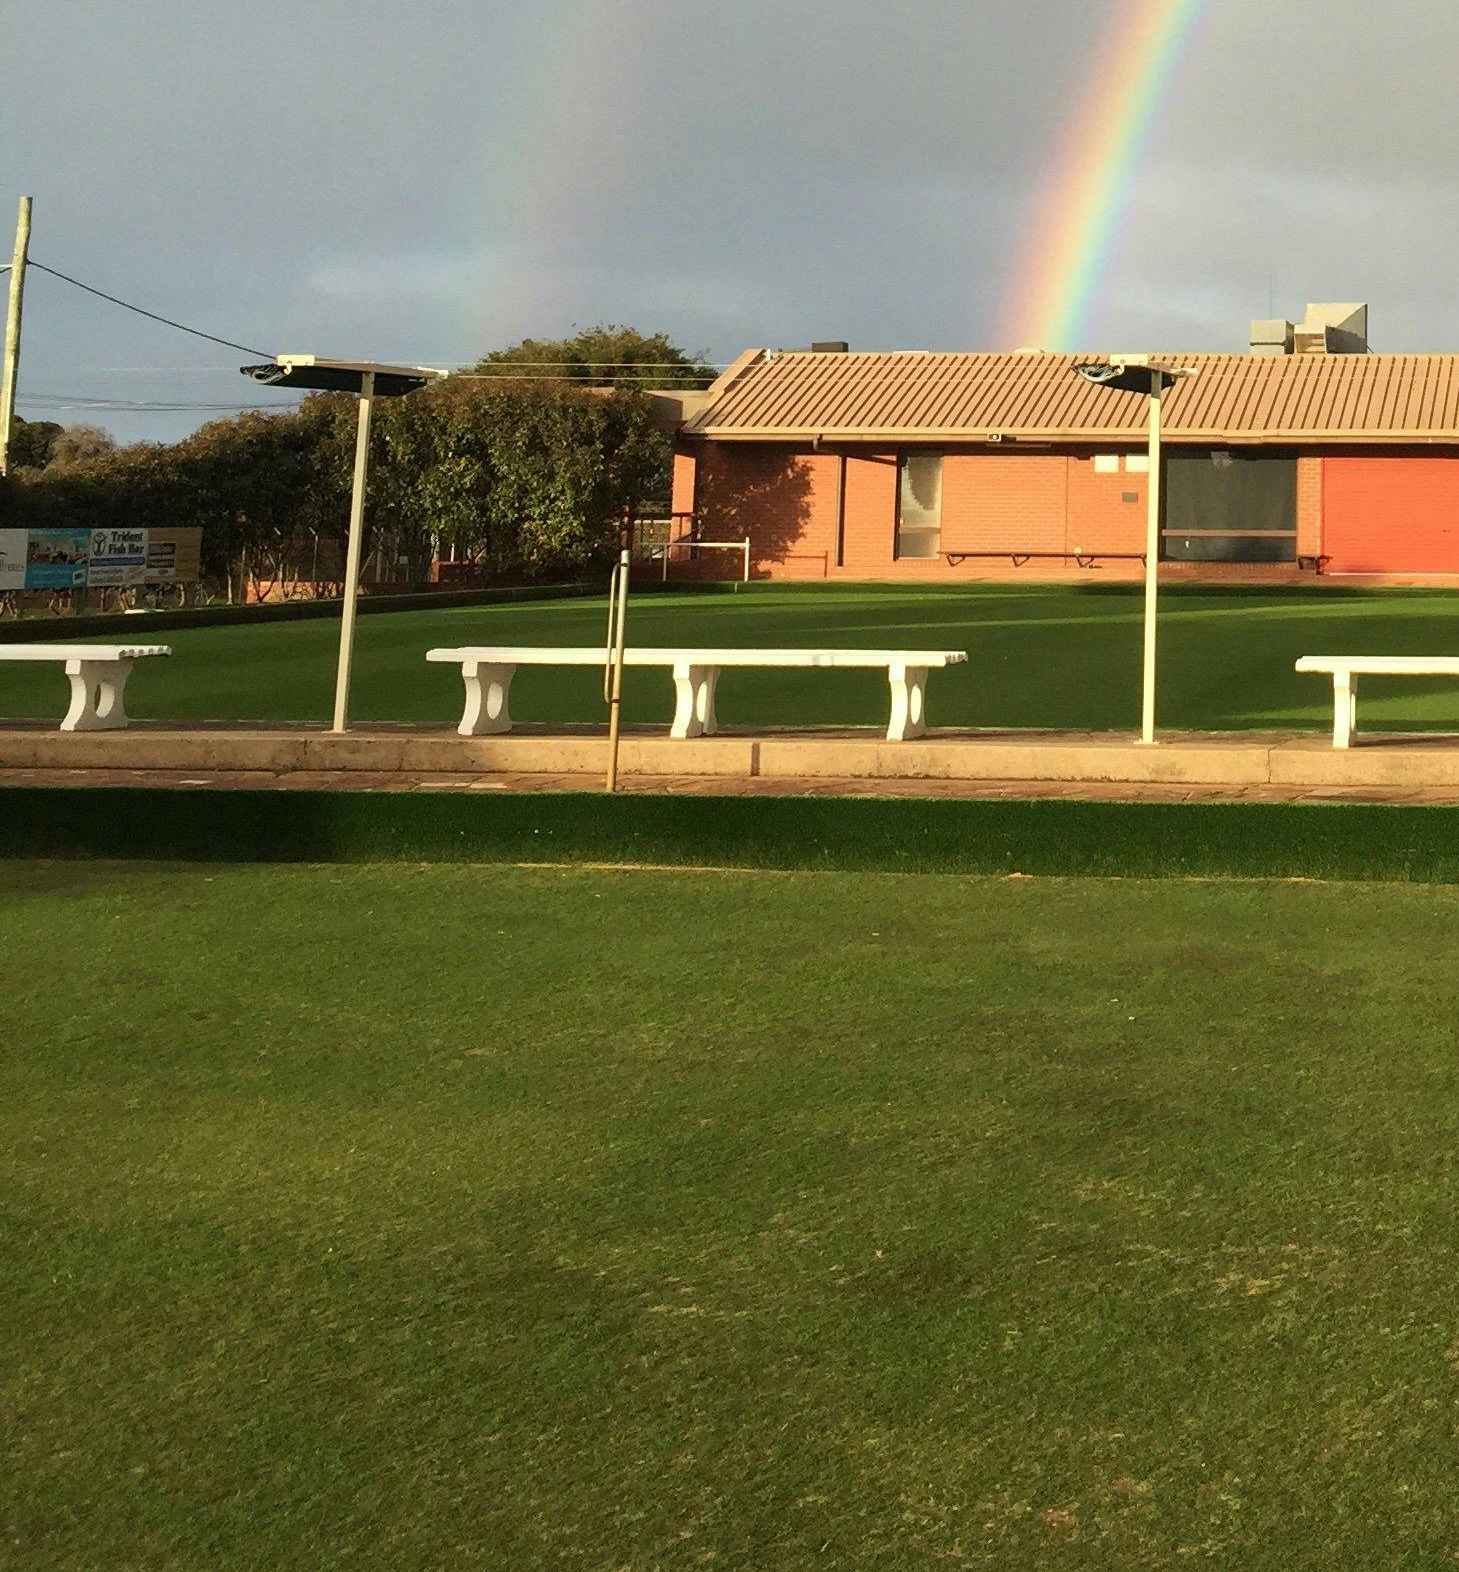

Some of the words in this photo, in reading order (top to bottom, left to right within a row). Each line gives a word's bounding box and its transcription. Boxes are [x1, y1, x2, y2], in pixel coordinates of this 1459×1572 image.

[111, 531, 144, 543] Trident
[108, 543, 127, 555] Fish
[128, 543, 145, 554] Bar
